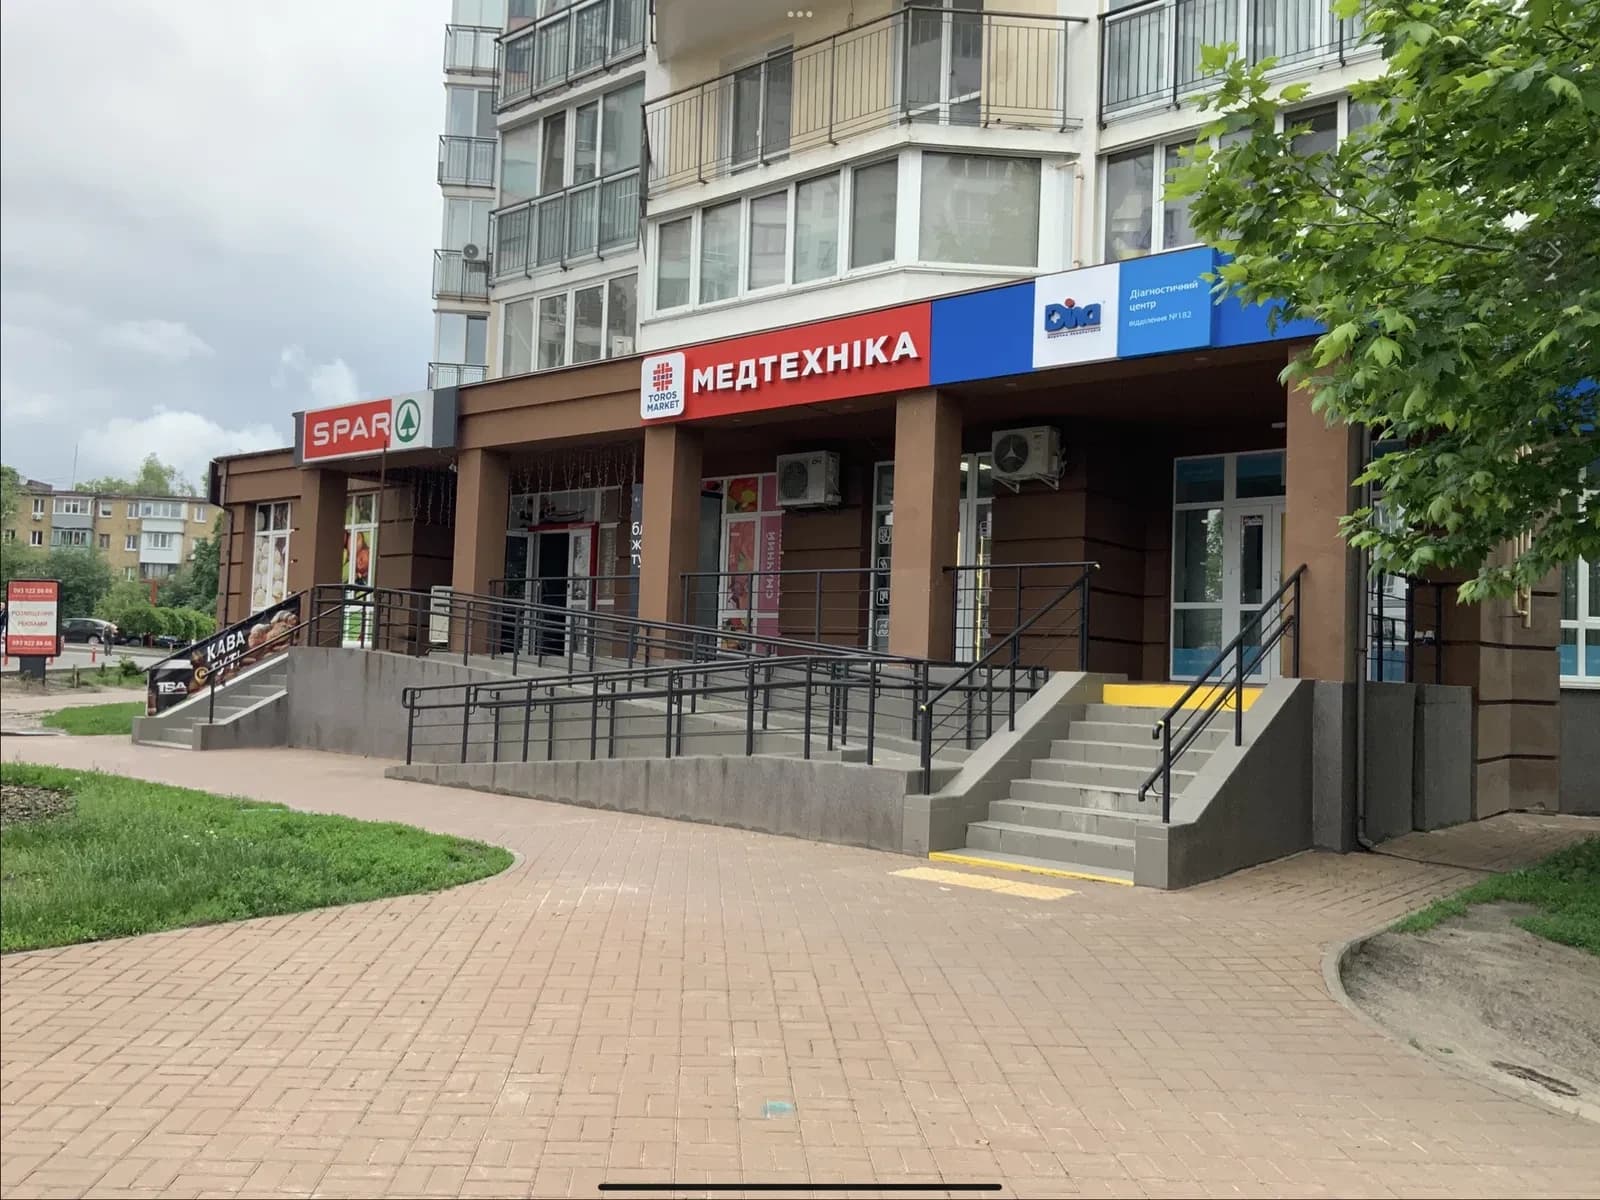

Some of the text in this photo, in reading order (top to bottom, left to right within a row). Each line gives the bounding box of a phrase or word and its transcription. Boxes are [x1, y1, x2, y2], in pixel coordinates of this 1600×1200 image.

[1129, 300, 1157, 312] центр
[692, 331, 918, 393] МЕДТЕХНІКА
[646, 400, 680, 413] MARKET
[648, 391, 678, 403] TOROS
[313, 412, 391, 446] SPAR
[206, 630, 246, 662] КАВА
